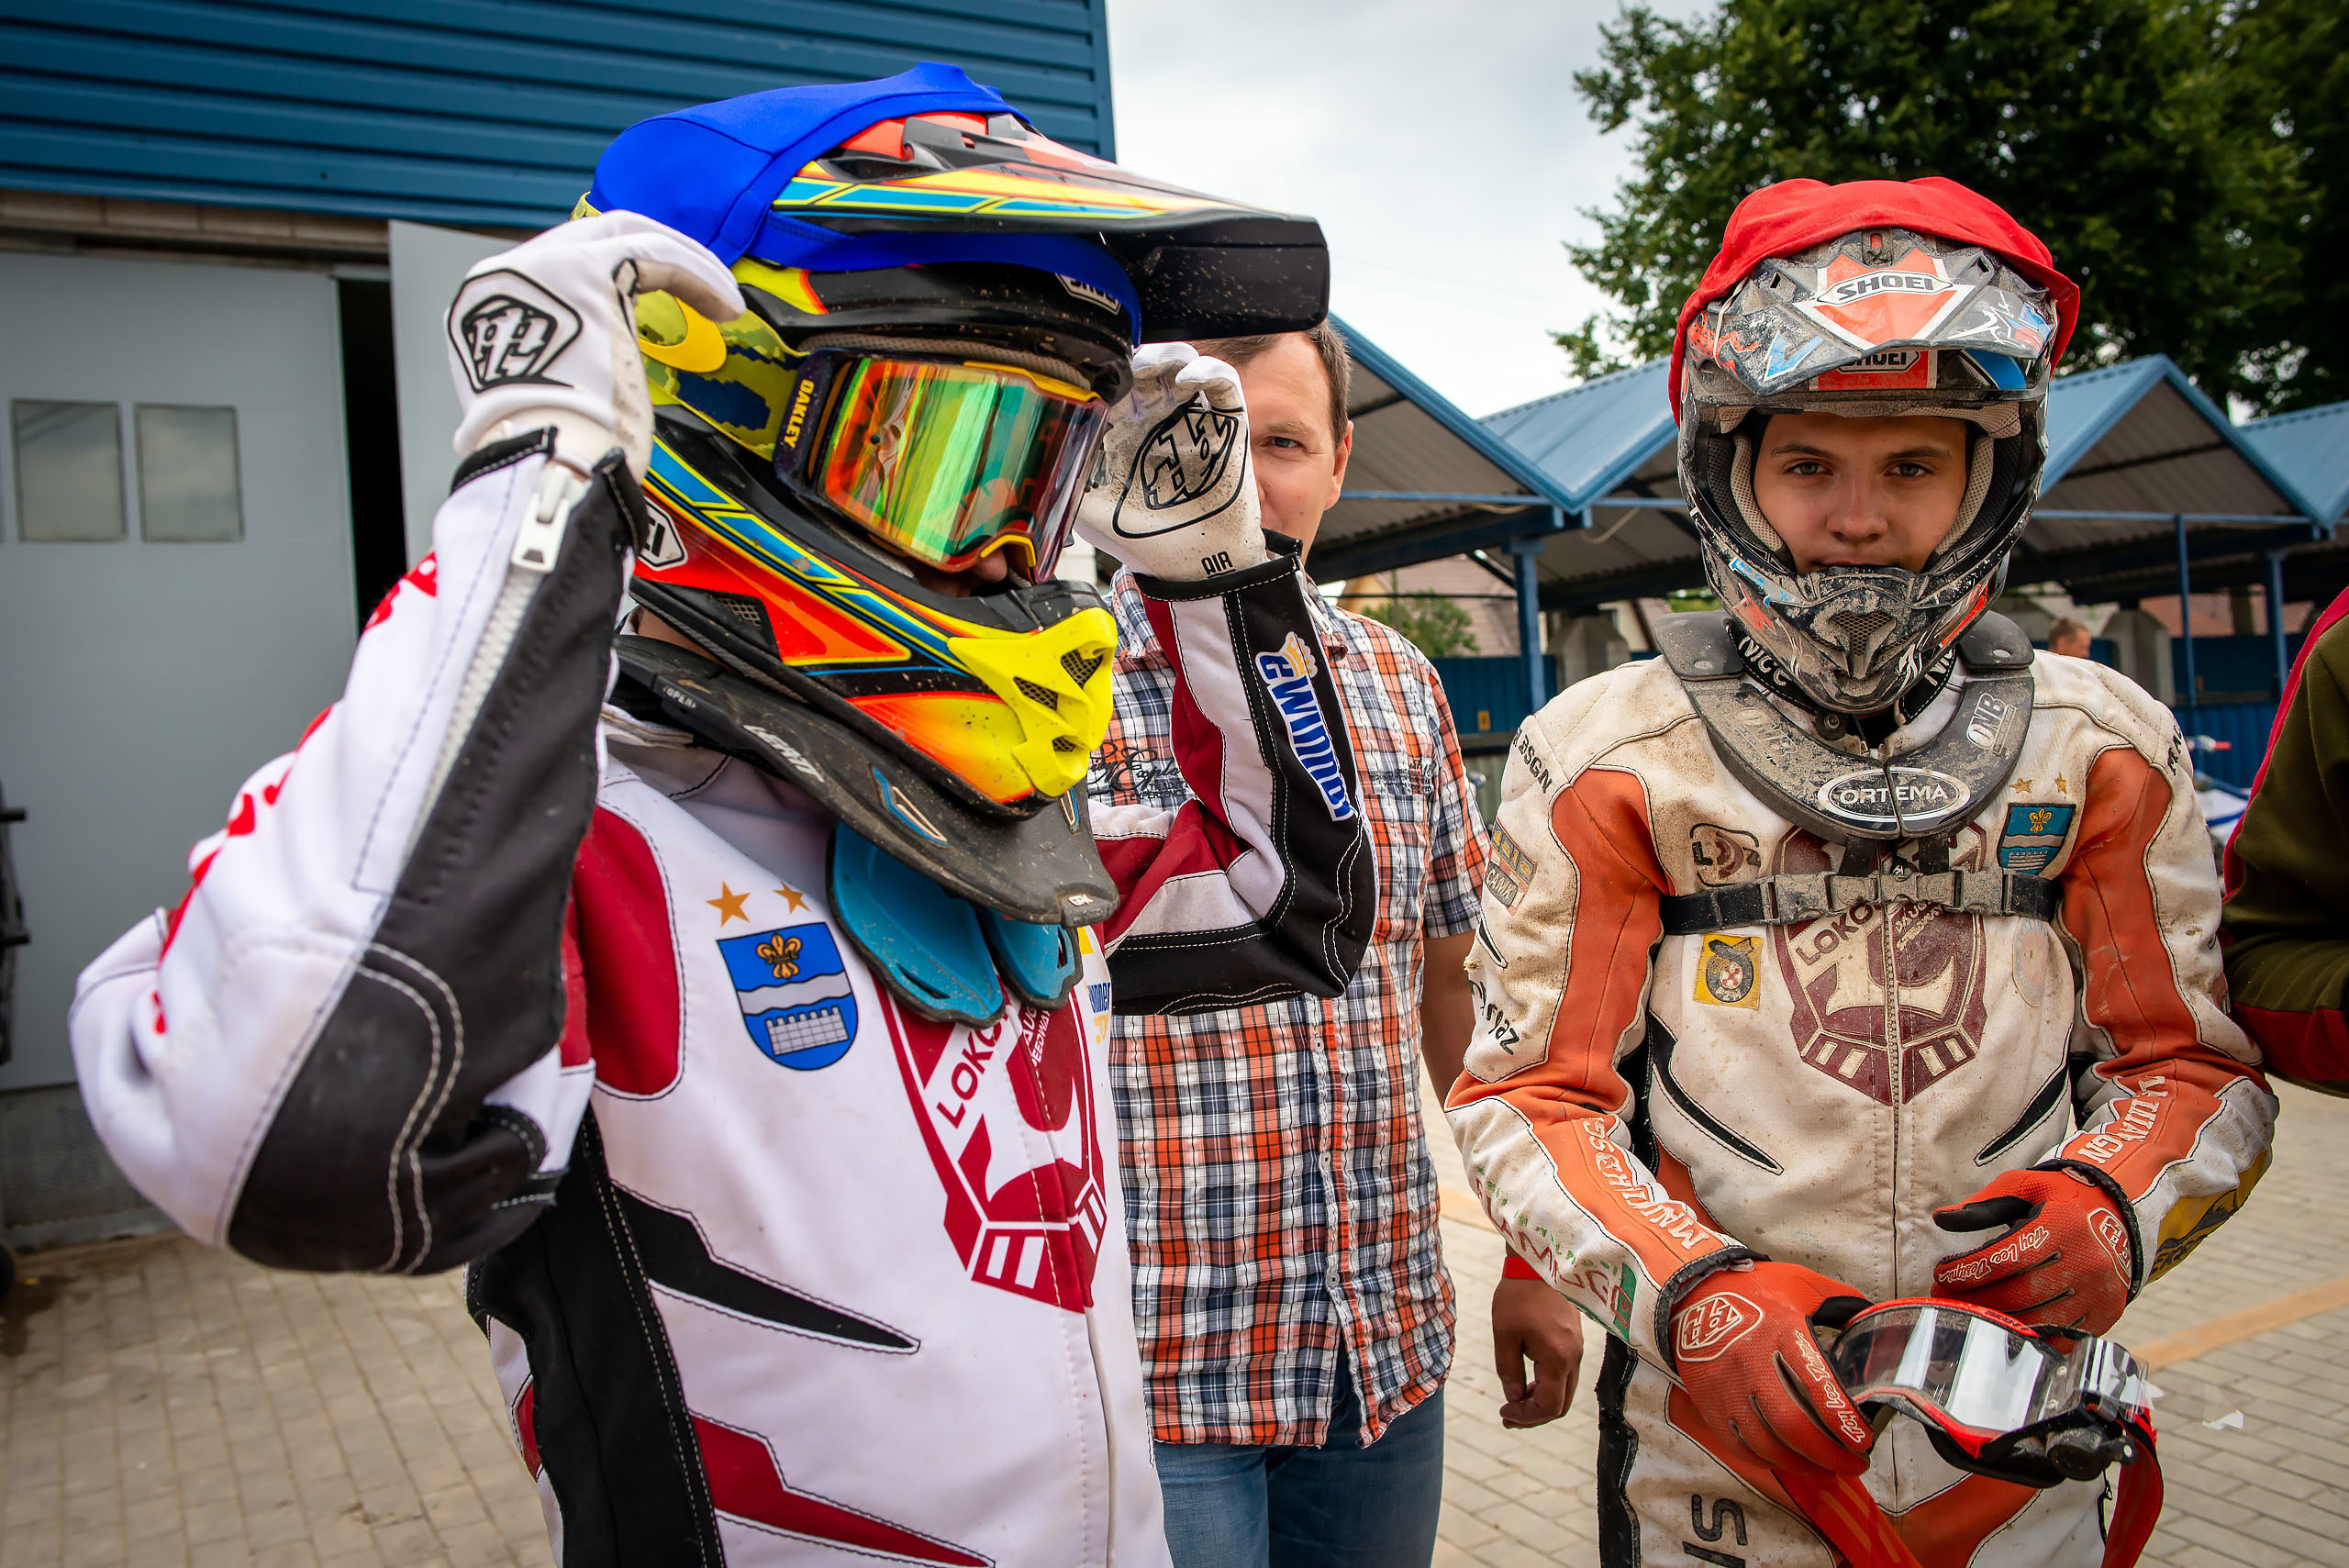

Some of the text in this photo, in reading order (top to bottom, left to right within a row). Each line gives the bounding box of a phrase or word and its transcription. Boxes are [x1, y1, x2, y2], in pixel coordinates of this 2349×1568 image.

[1836, 274, 1934, 301] SHOEI
[1850, 351, 1907, 366] HOEI
[784, 378, 815, 449] OAKLEY
[1201, 550, 1234, 576] AIR
[1966, 694, 2008, 751] ONB
[1839, 784, 1949, 806] ORTEMA
[1795, 903, 1874, 966] LOKO
[1894, 903, 1929, 934] DAUG
[936, 1011, 1008, 1129] LOKO
[1938, 1226, 2050, 1284] Troy Lee Designs
[1823, 1381, 1846, 1409] Lee
[1837, 1410, 1866, 1444] Troy
